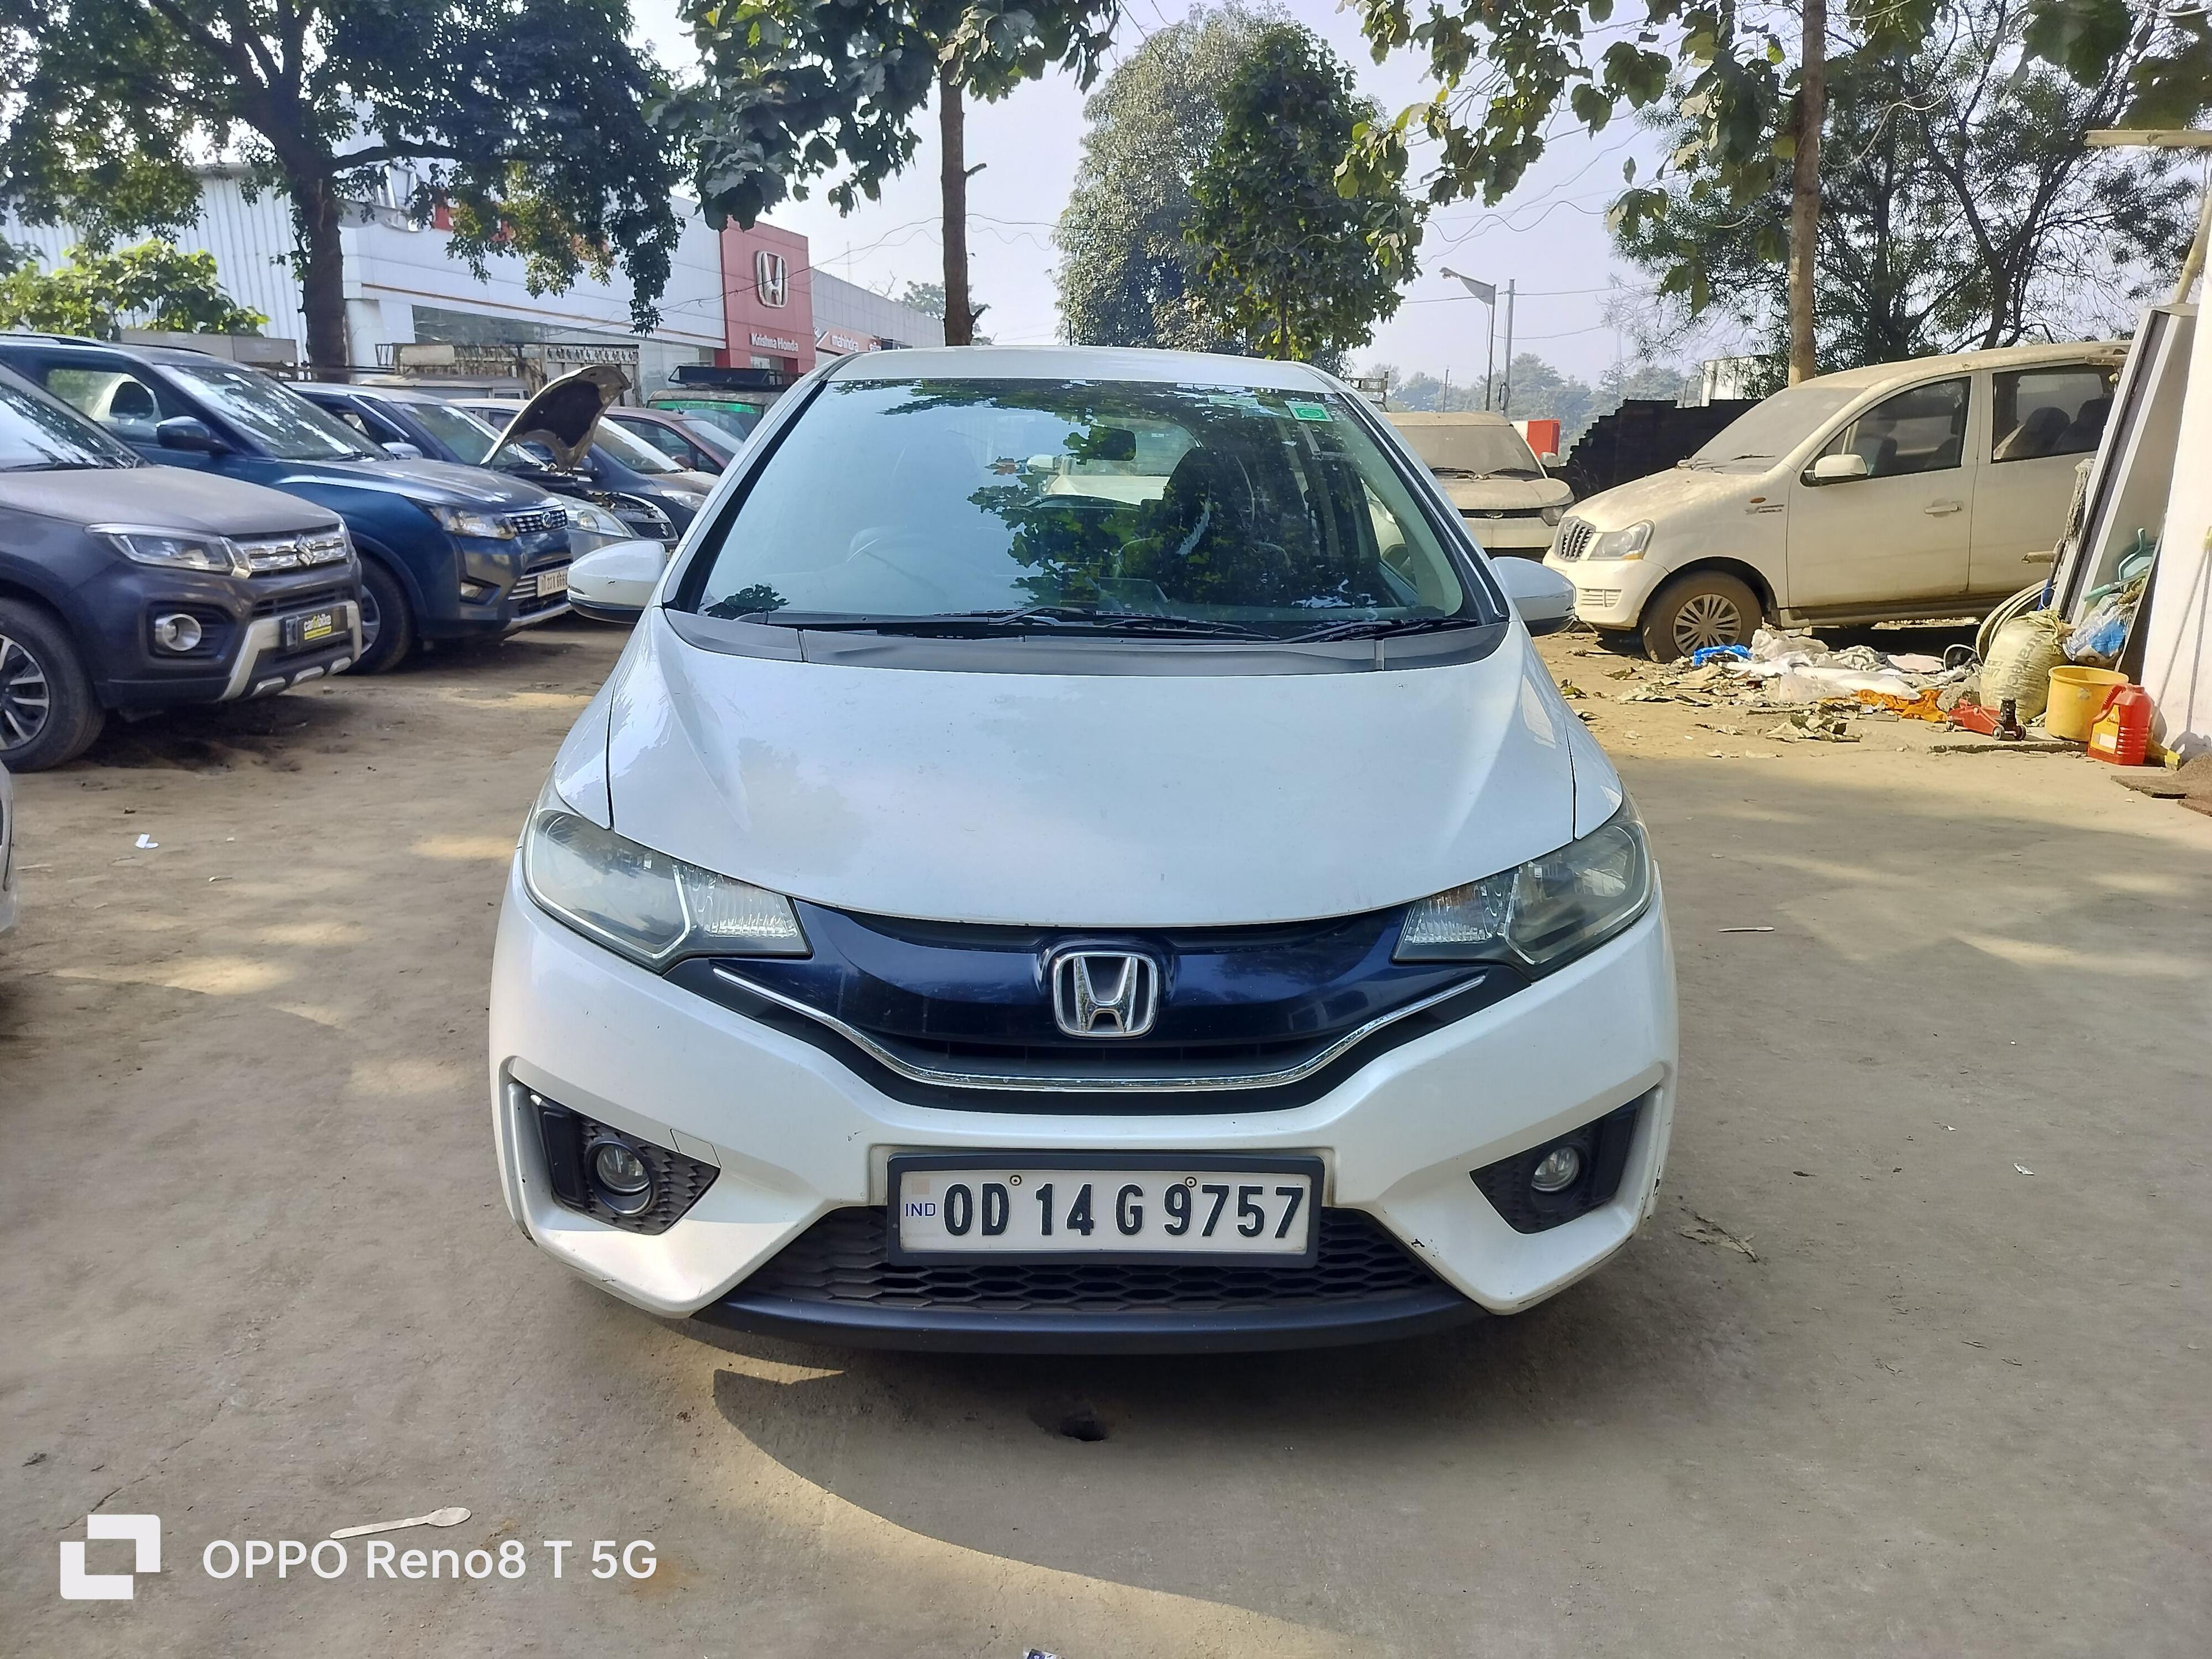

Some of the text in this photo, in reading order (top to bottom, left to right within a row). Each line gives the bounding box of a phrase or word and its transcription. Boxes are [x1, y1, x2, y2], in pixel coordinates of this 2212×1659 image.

[750, 333, 798, 351] Krishna Honda
[905, 1202, 935, 1217] IND
[944, 1183, 1304, 1239] OD 14 G 9757
